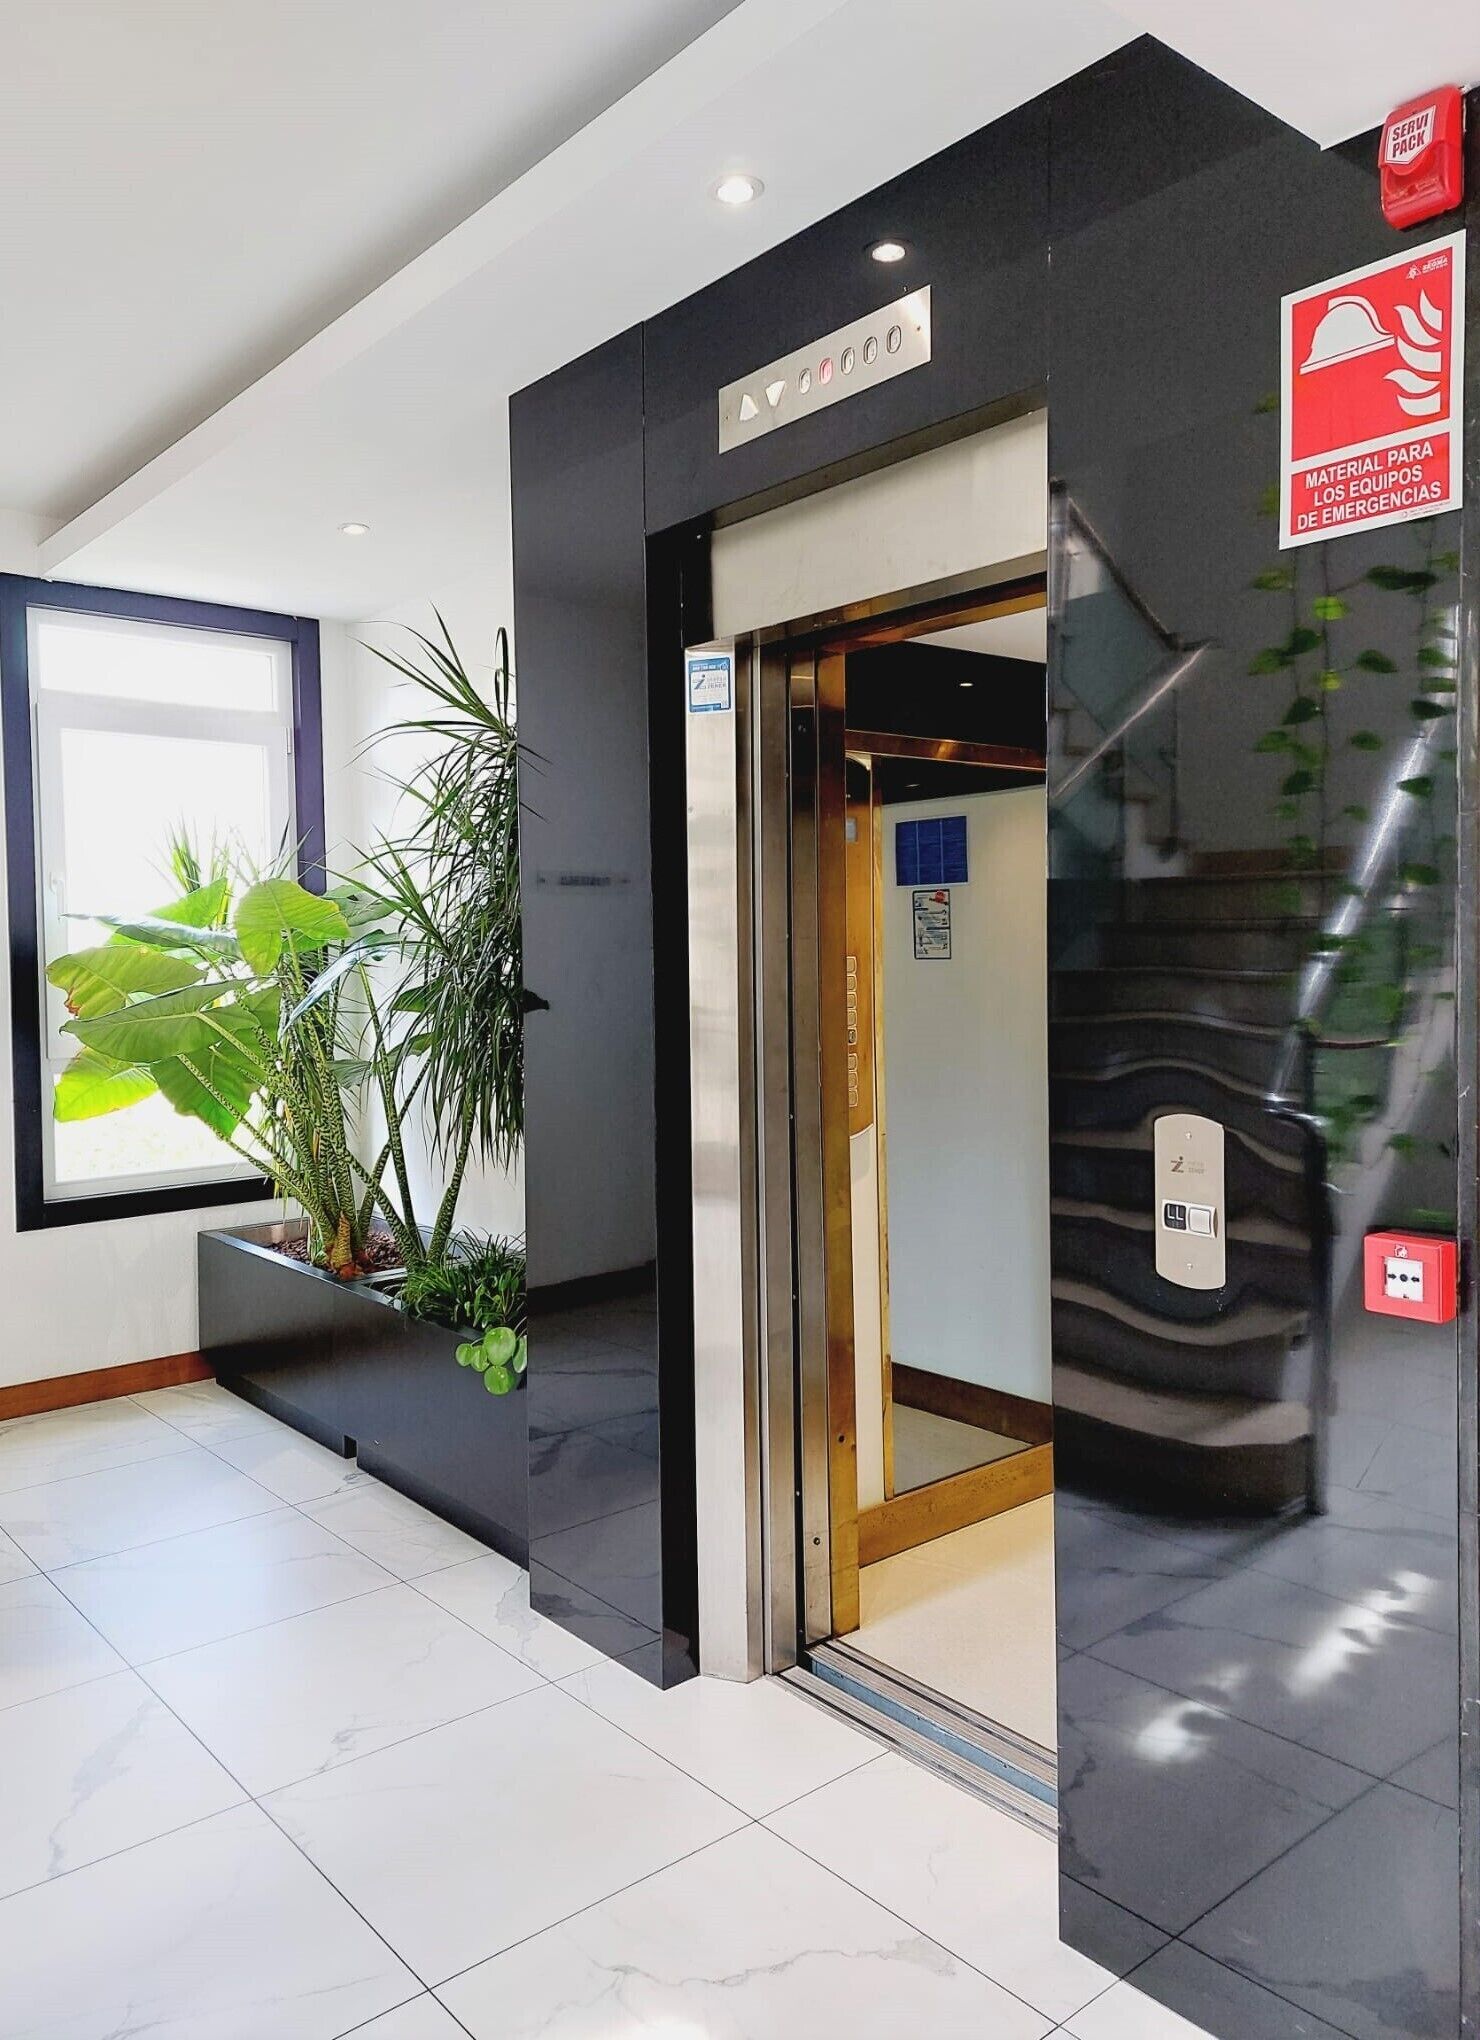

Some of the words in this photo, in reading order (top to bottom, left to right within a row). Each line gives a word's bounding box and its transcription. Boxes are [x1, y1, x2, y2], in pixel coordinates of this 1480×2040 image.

[1392, 113, 1429, 141] SERVI
[1392, 130, 1425, 158] PACK
[1306, 457, 1383, 489] MATERIAL
[1387, 441, 1433, 467] PARA
[1314, 484, 1345, 507] LOS
[1350, 465, 1423, 498] EQUIPOS
[1297, 511, 1317, 530] DE
[1322, 481, 1441, 525] EMERGENCIAS
